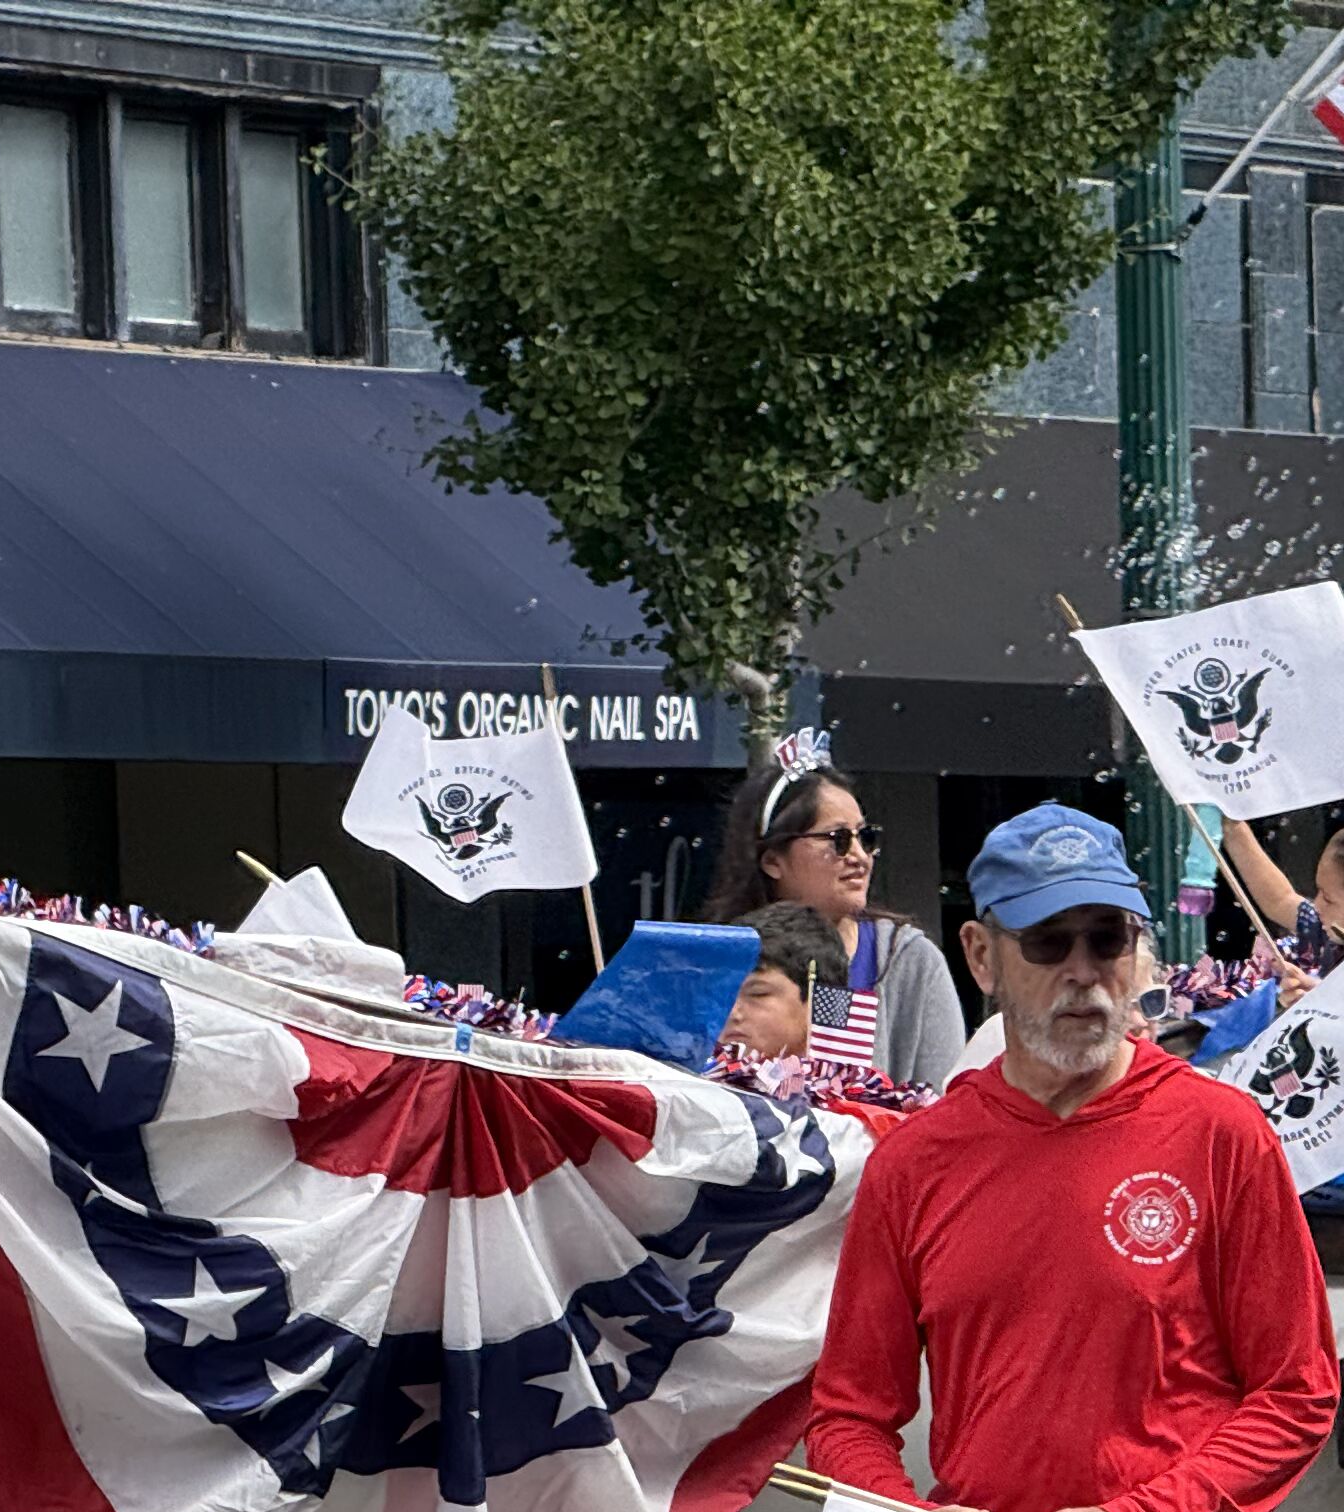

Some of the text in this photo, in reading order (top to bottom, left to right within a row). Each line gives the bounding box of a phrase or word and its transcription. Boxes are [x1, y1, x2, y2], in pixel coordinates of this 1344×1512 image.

[1164, 643, 1202, 668] STATES
[1213, 637, 1250, 650] COAST
[1261, 649, 1295, 678] GUARD
[458, 692, 580, 740] ORGANC
[590, 696, 646, 741] NAIL
[655, 695, 701, 741] SPA
[1224, 779, 1252, 794] 1790
